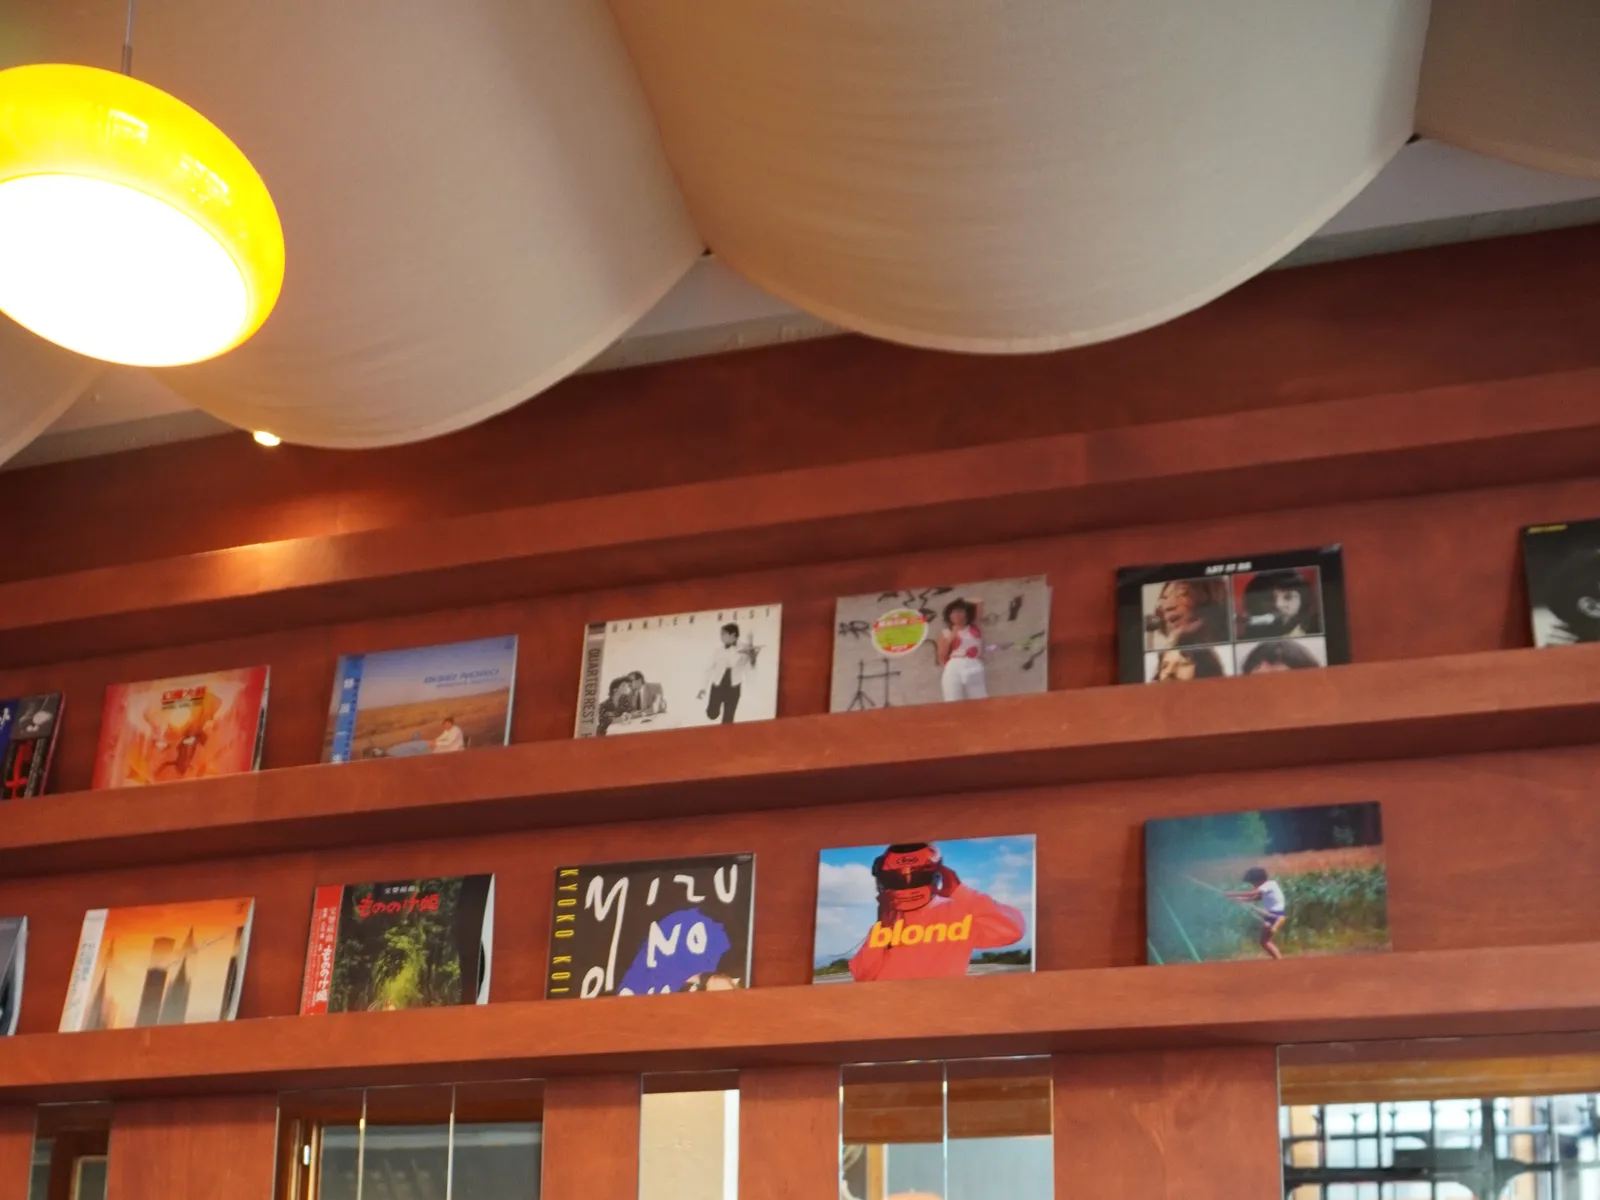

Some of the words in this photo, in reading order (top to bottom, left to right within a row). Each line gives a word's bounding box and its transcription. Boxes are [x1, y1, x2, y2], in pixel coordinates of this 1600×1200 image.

[583, 648, 600, 697] QUARTER
[580, 696, 595, 725] REST
[356, 891, 441, 919] もののけ姫
[554, 868, 579, 938] KYOKO
[646, 920, 708, 969] NO
[869, 914, 973, 948] blond
